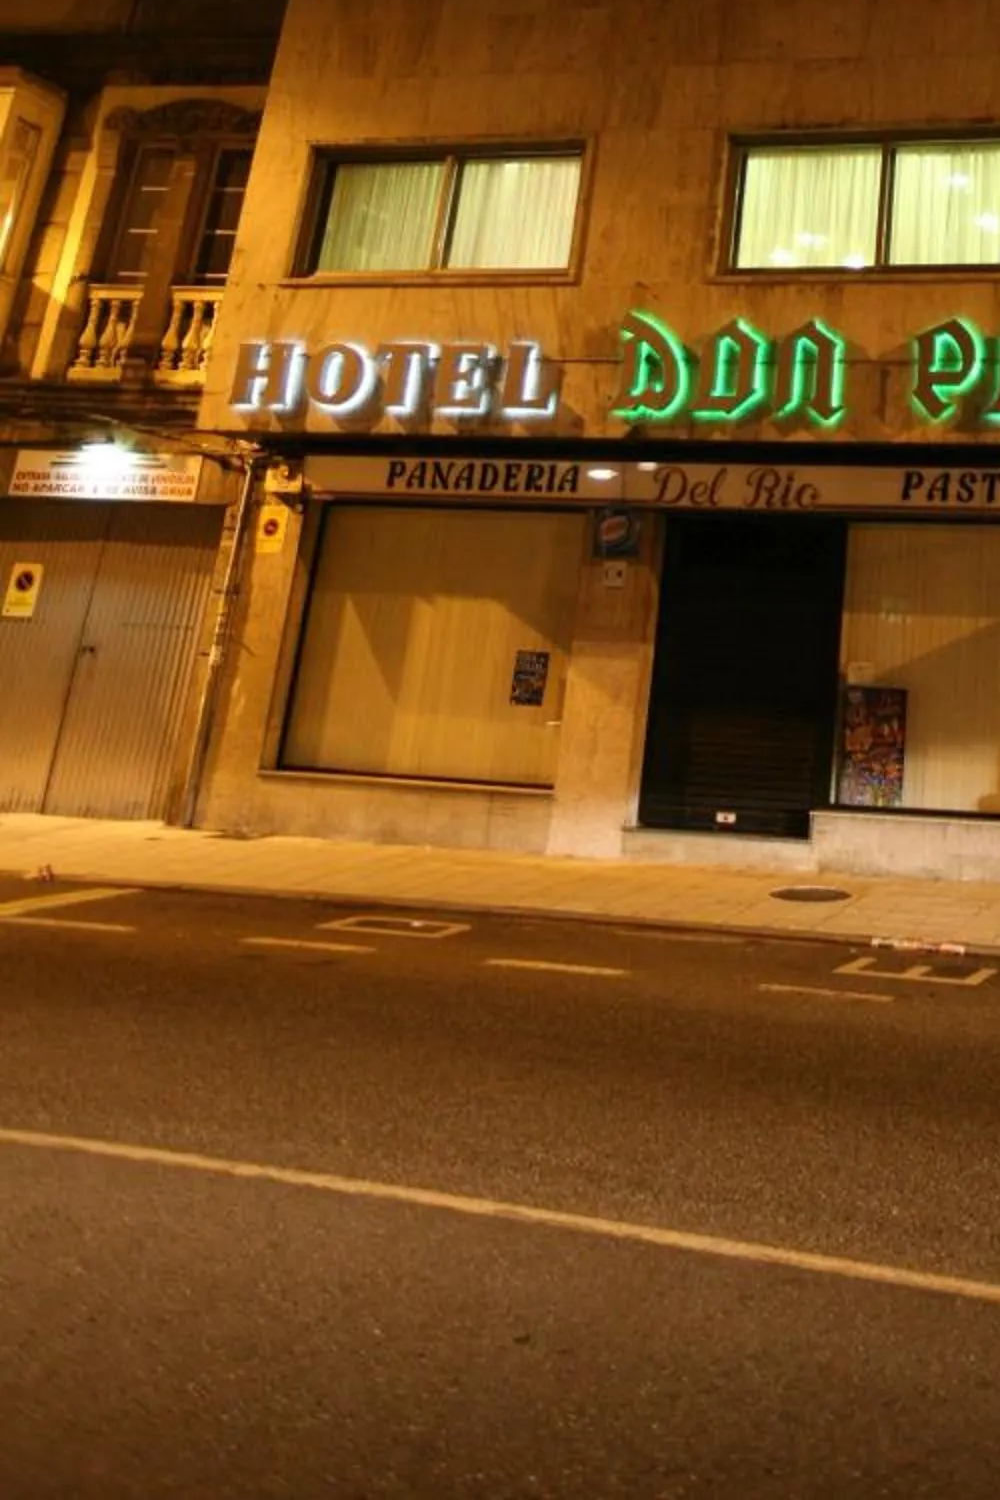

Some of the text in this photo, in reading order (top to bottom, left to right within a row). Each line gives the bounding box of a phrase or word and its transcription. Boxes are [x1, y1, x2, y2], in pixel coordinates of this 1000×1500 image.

[229, 340, 558, 414] HOTEL
[608, 308, 844, 425] DON
[386, 459, 580, 494] PANADERIA
[652, 466, 728, 507] Del
